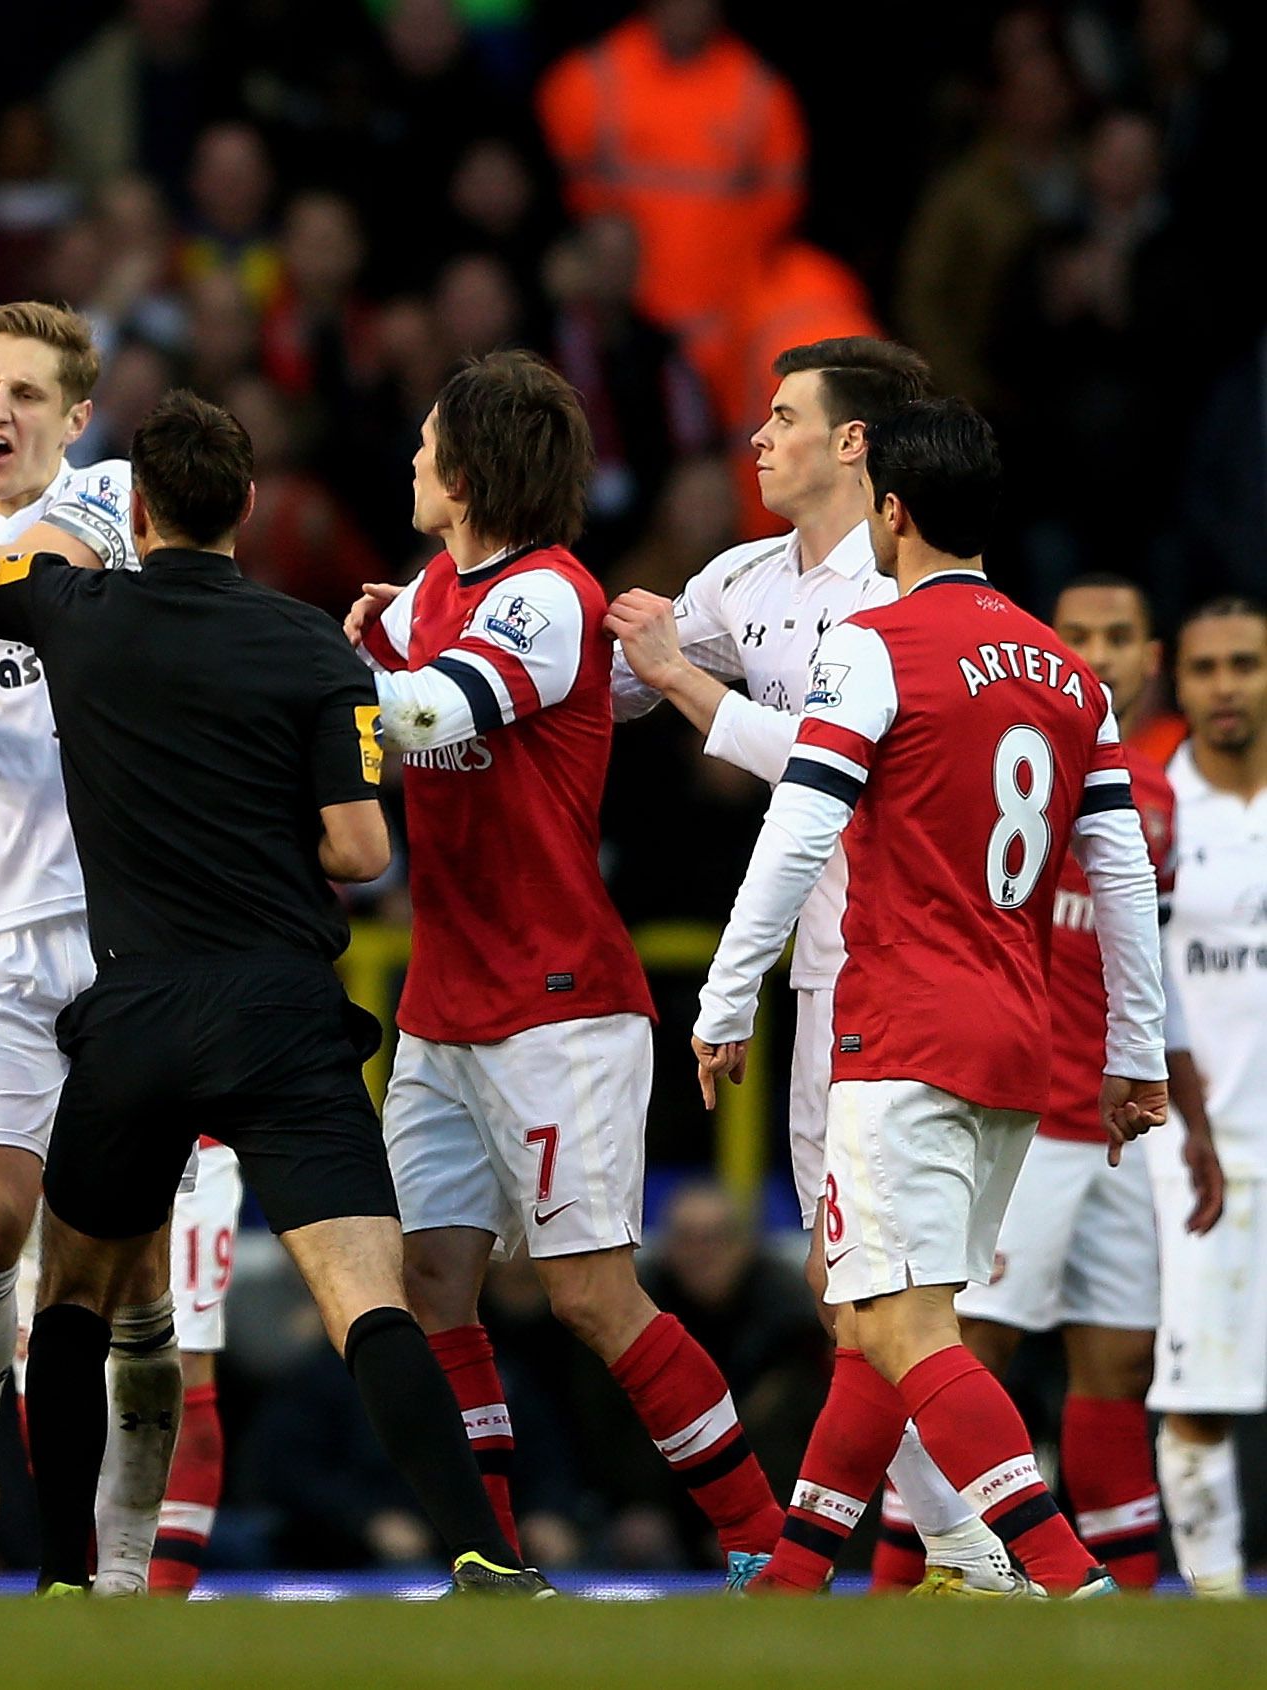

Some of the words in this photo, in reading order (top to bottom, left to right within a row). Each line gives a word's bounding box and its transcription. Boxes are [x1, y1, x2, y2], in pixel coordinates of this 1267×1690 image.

[958, 641, 1084, 709] ARTETA
[986, 724, 1054, 909] 8
[524, 1124, 560, 1203] 7
[186, 1225, 233, 1292] 19
